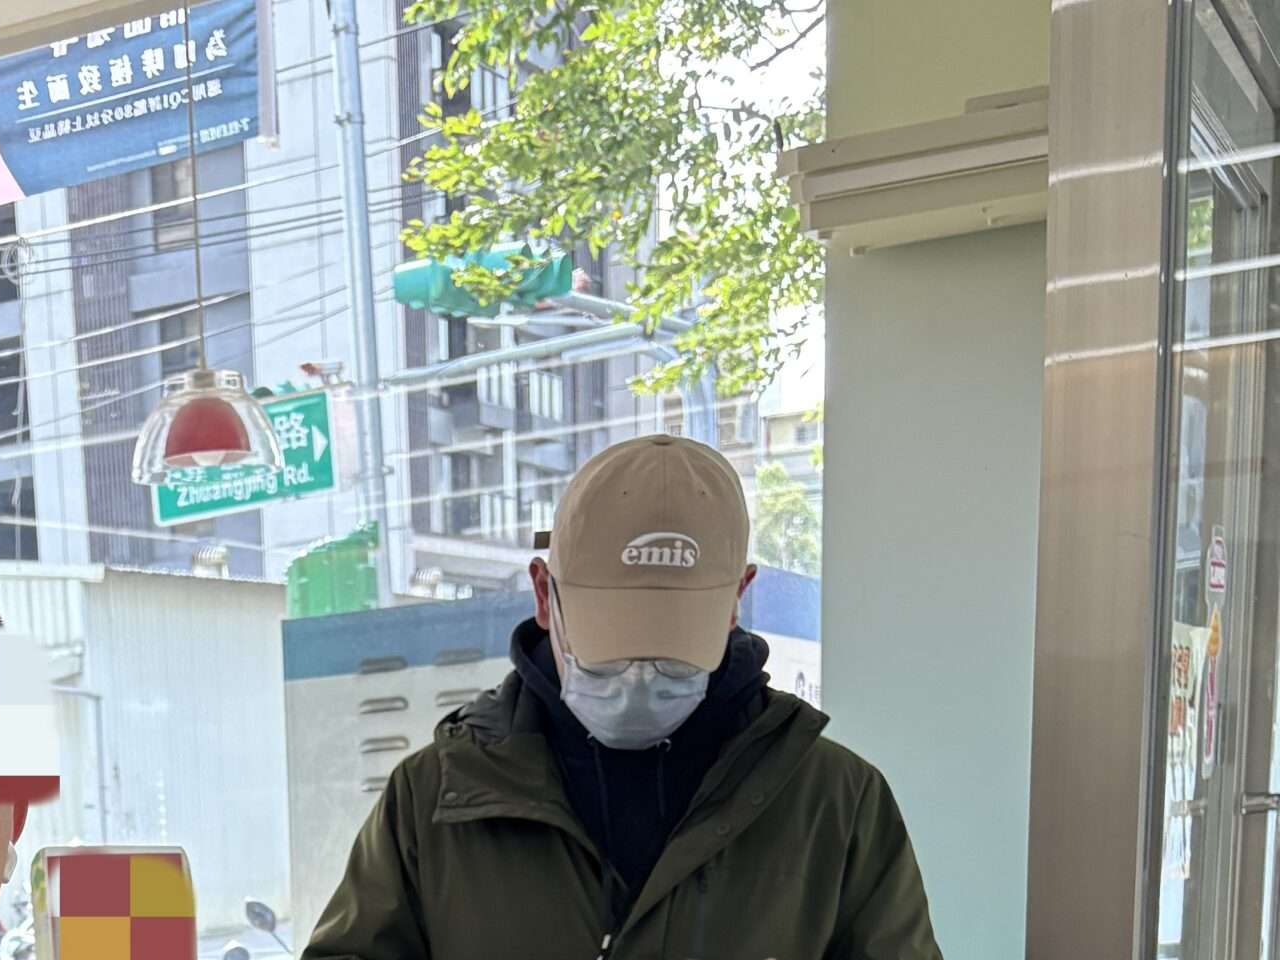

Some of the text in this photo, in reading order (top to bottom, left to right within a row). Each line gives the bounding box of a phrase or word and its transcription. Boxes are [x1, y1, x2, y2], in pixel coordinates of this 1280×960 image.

[176, 469, 278, 507] Zhuangjing
[283, 462, 314, 487] Rd.
[621, 540, 696, 568] emis
